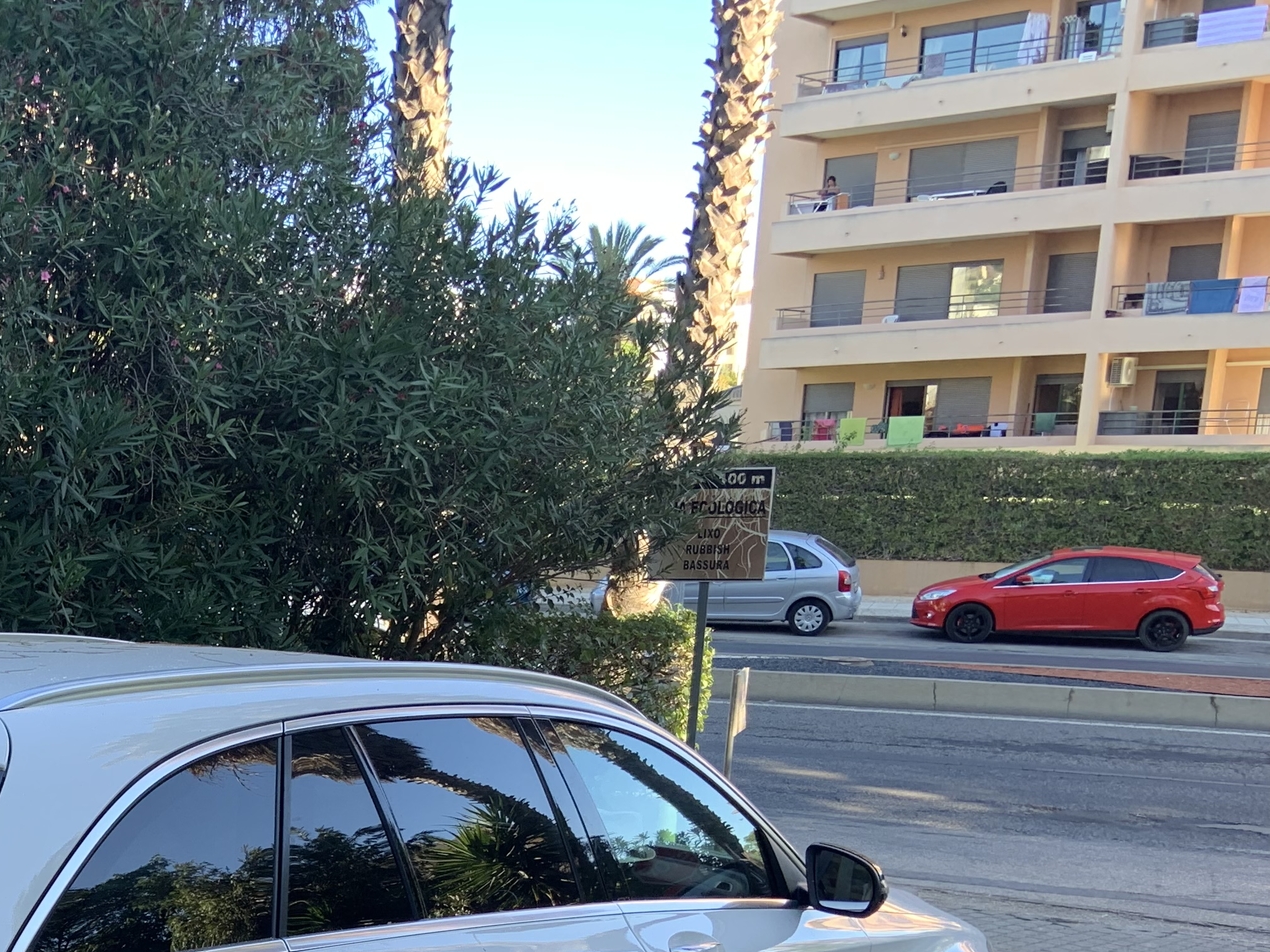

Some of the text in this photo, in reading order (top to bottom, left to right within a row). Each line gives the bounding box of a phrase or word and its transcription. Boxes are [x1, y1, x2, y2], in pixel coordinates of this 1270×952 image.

[751, 475, 765, 485] m
[686, 544, 730, 555] RUBBISH
[683, 560, 729, 570] BASSURA
